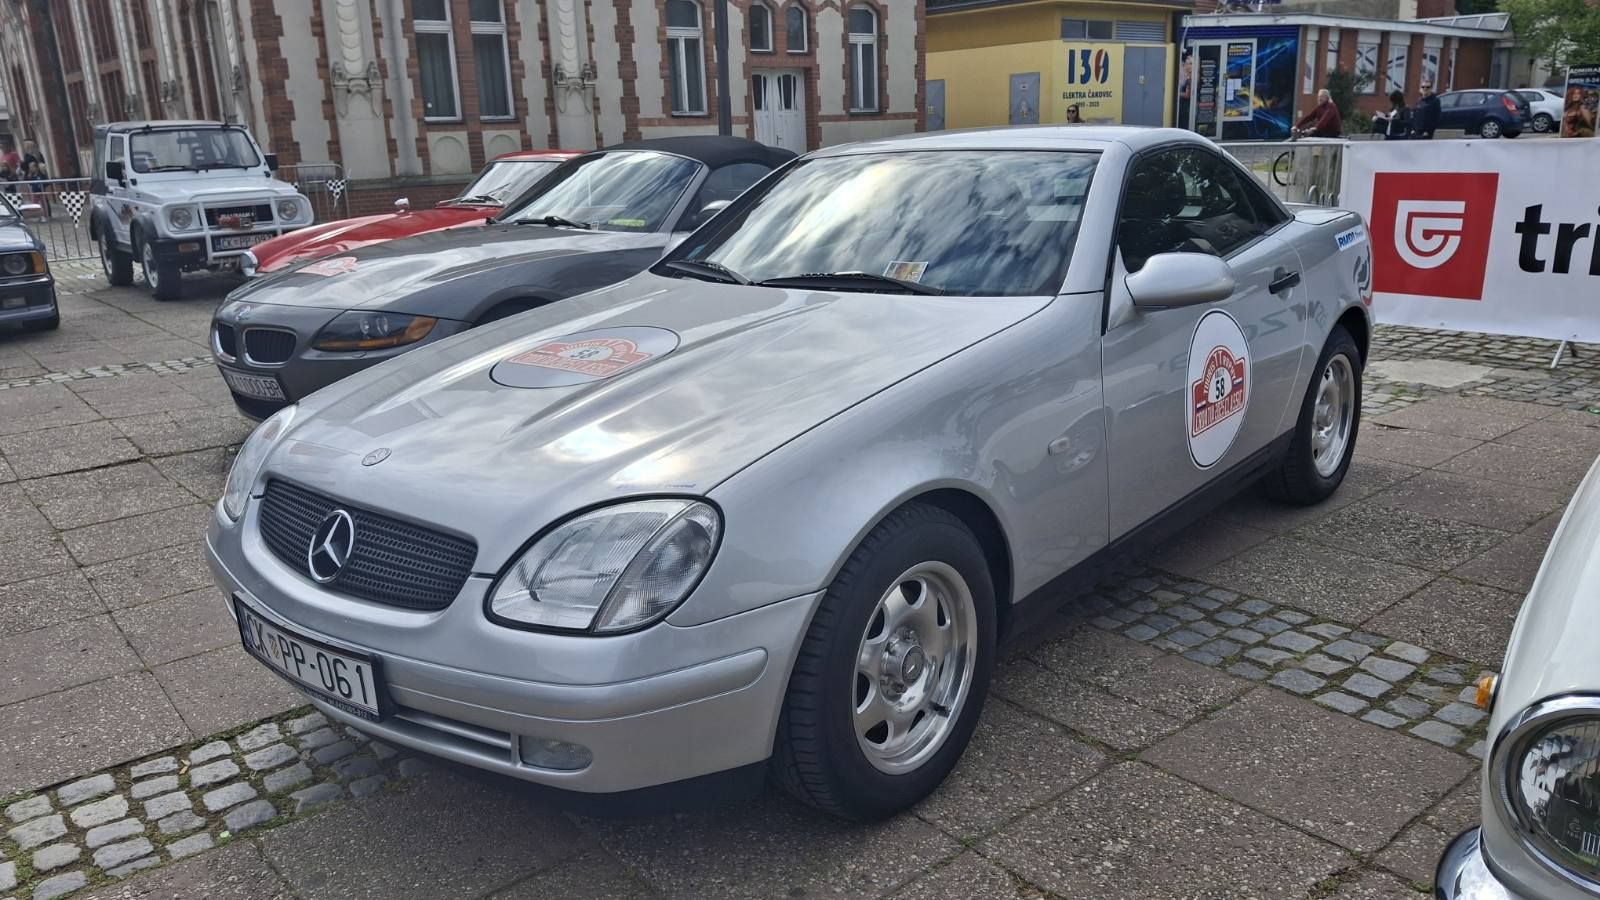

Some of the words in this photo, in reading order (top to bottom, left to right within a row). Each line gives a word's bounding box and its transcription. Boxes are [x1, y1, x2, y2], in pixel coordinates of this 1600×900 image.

[1068, 48, 1109, 84] 130
[1063, 91, 1086, 99] ELEKTRA
[1088, 89, 1112, 98] ČAKOVEC
[1338, 231, 1355, 247] RUDI
[1515, 203, 1600, 276] tri
[1215, 377, 1225, 400] 58
[277, 633, 368, 705] PP-061
